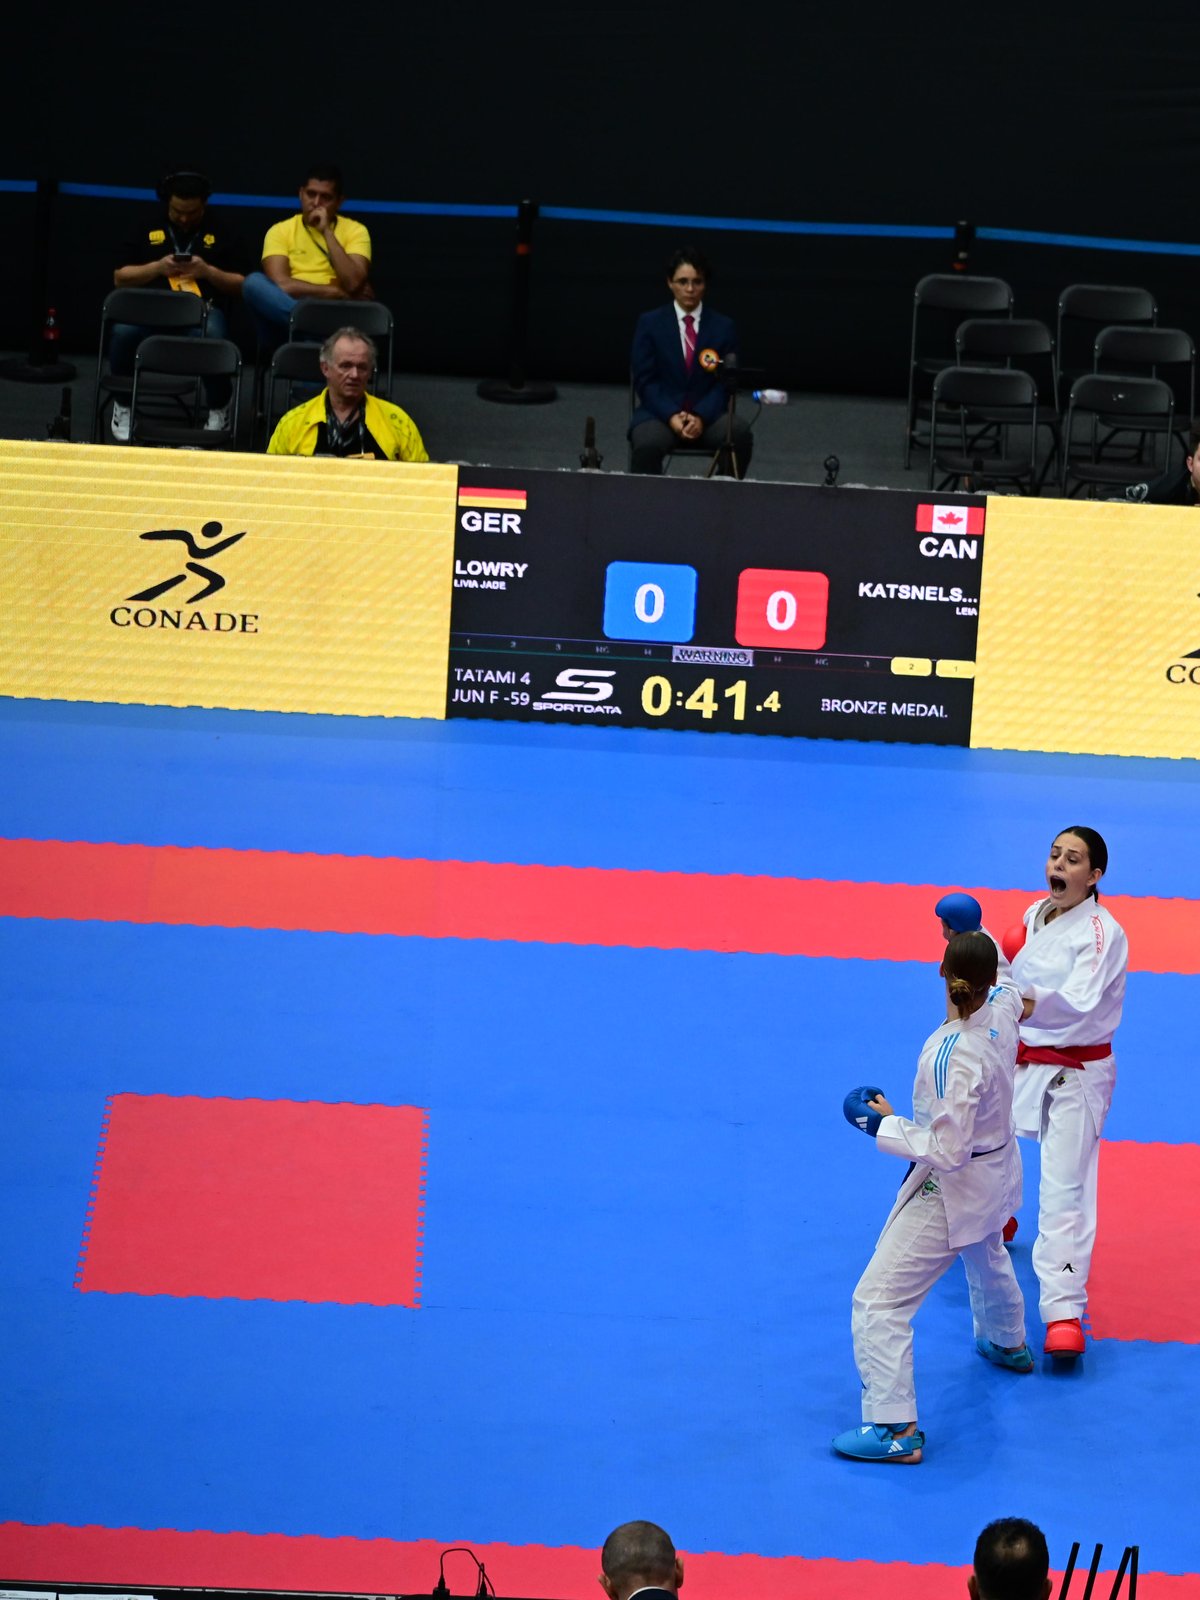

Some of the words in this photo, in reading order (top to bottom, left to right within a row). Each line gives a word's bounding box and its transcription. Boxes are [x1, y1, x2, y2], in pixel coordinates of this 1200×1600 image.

[461, 511, 522, 534] GER
[919, 536, 978, 560] CAN
[455, 560, 528, 578] LOWRY
[454, 579, 478, 589] LIVIA
[480, 580, 506, 590] JADE
[858, 582, 978, 604] KATSNELS...
[635, 583, 665, 623] 0
[766, 590, 797, 631] 0
[955, 606, 978, 616] LEIA
[110, 606, 259, 634] CONADE
[678, 648, 749, 664] WARNING
[455, 667, 517, 684] TATAMI
[520, 672, 531, 685] 4
[908, 663, 915, 671] 2
[452, 688, 485, 704] JUN
[490, 690, 499, 704] F
[504, 691, 531, 706] -59
[532, 702, 622, 715] SPORTDATA
[821, 698, 887, 715] BRONZE
[891, 702, 948, 718] MEDAL
